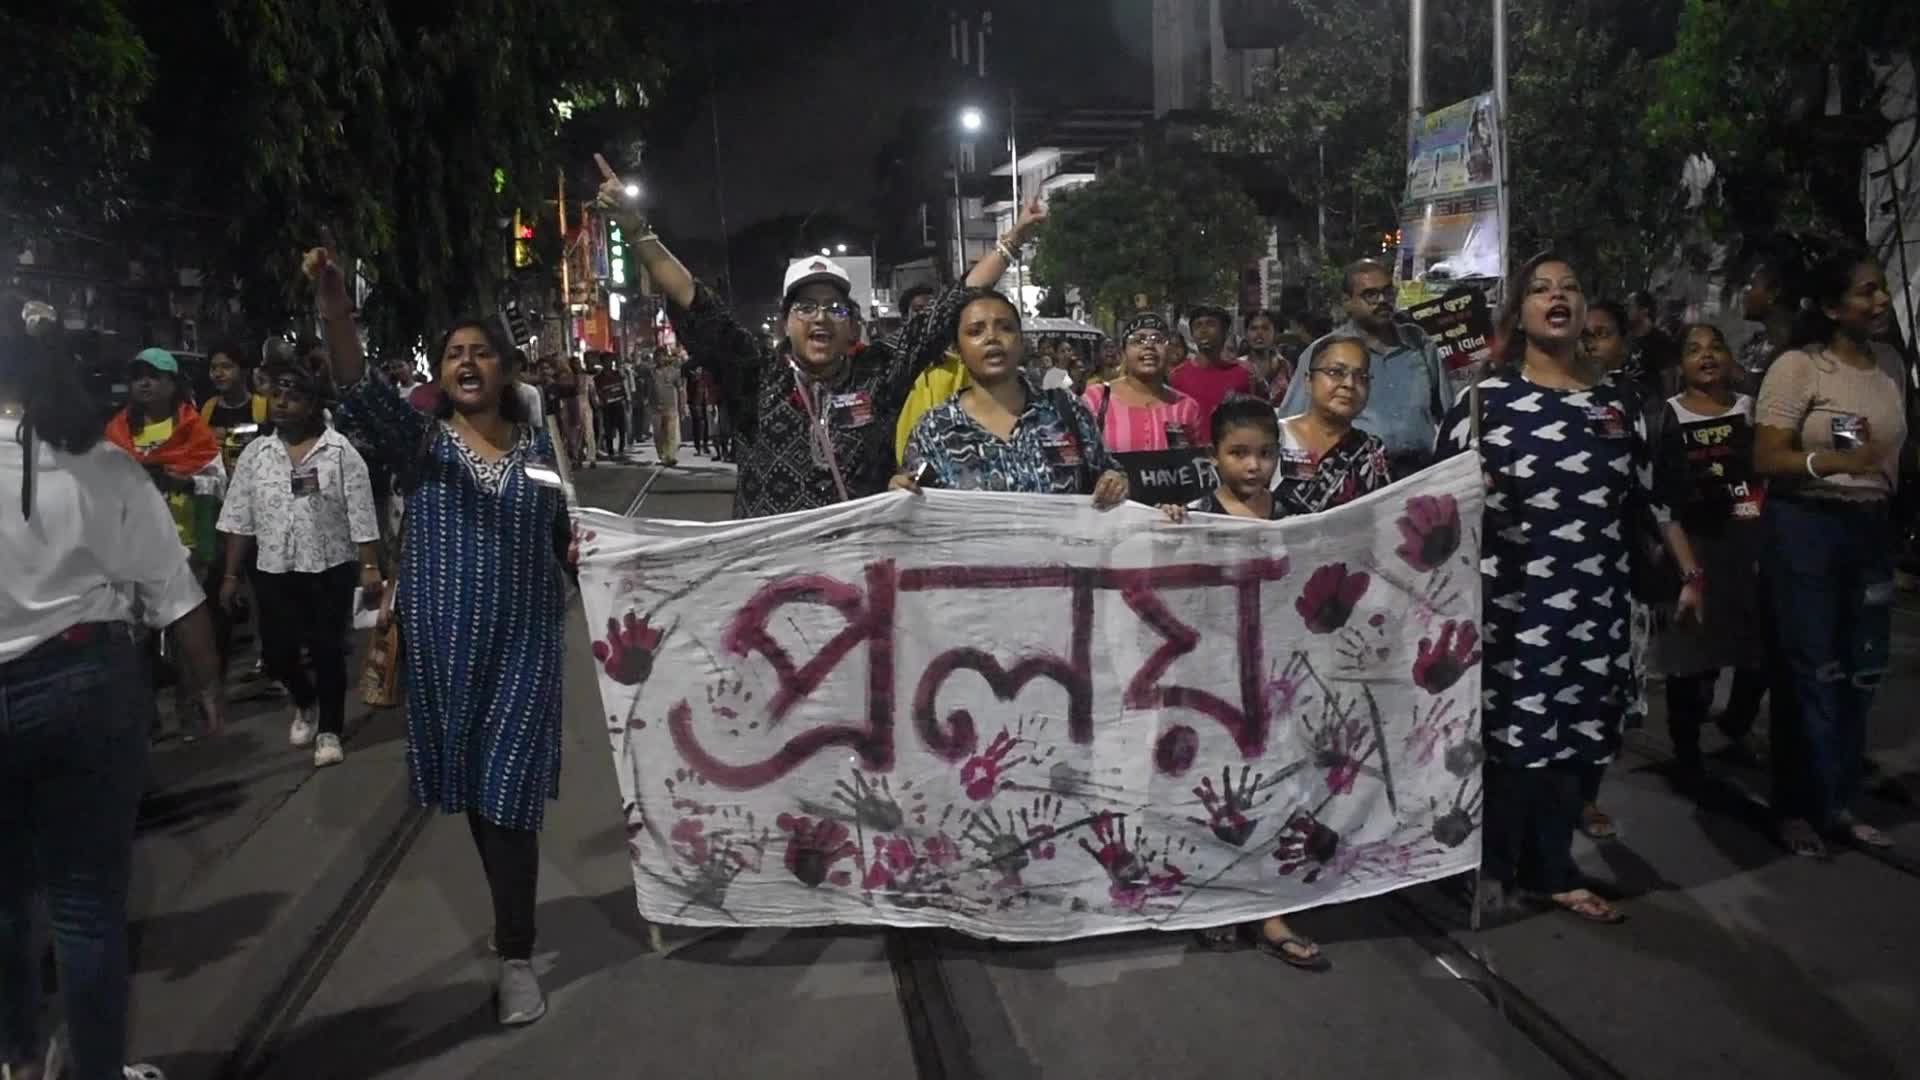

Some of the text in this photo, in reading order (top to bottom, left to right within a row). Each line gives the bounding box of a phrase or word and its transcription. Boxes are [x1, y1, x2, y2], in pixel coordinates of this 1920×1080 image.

[1140, 457, 1222, 489] HAVE FA
[668, 556, 1290, 792] প্রলয়
